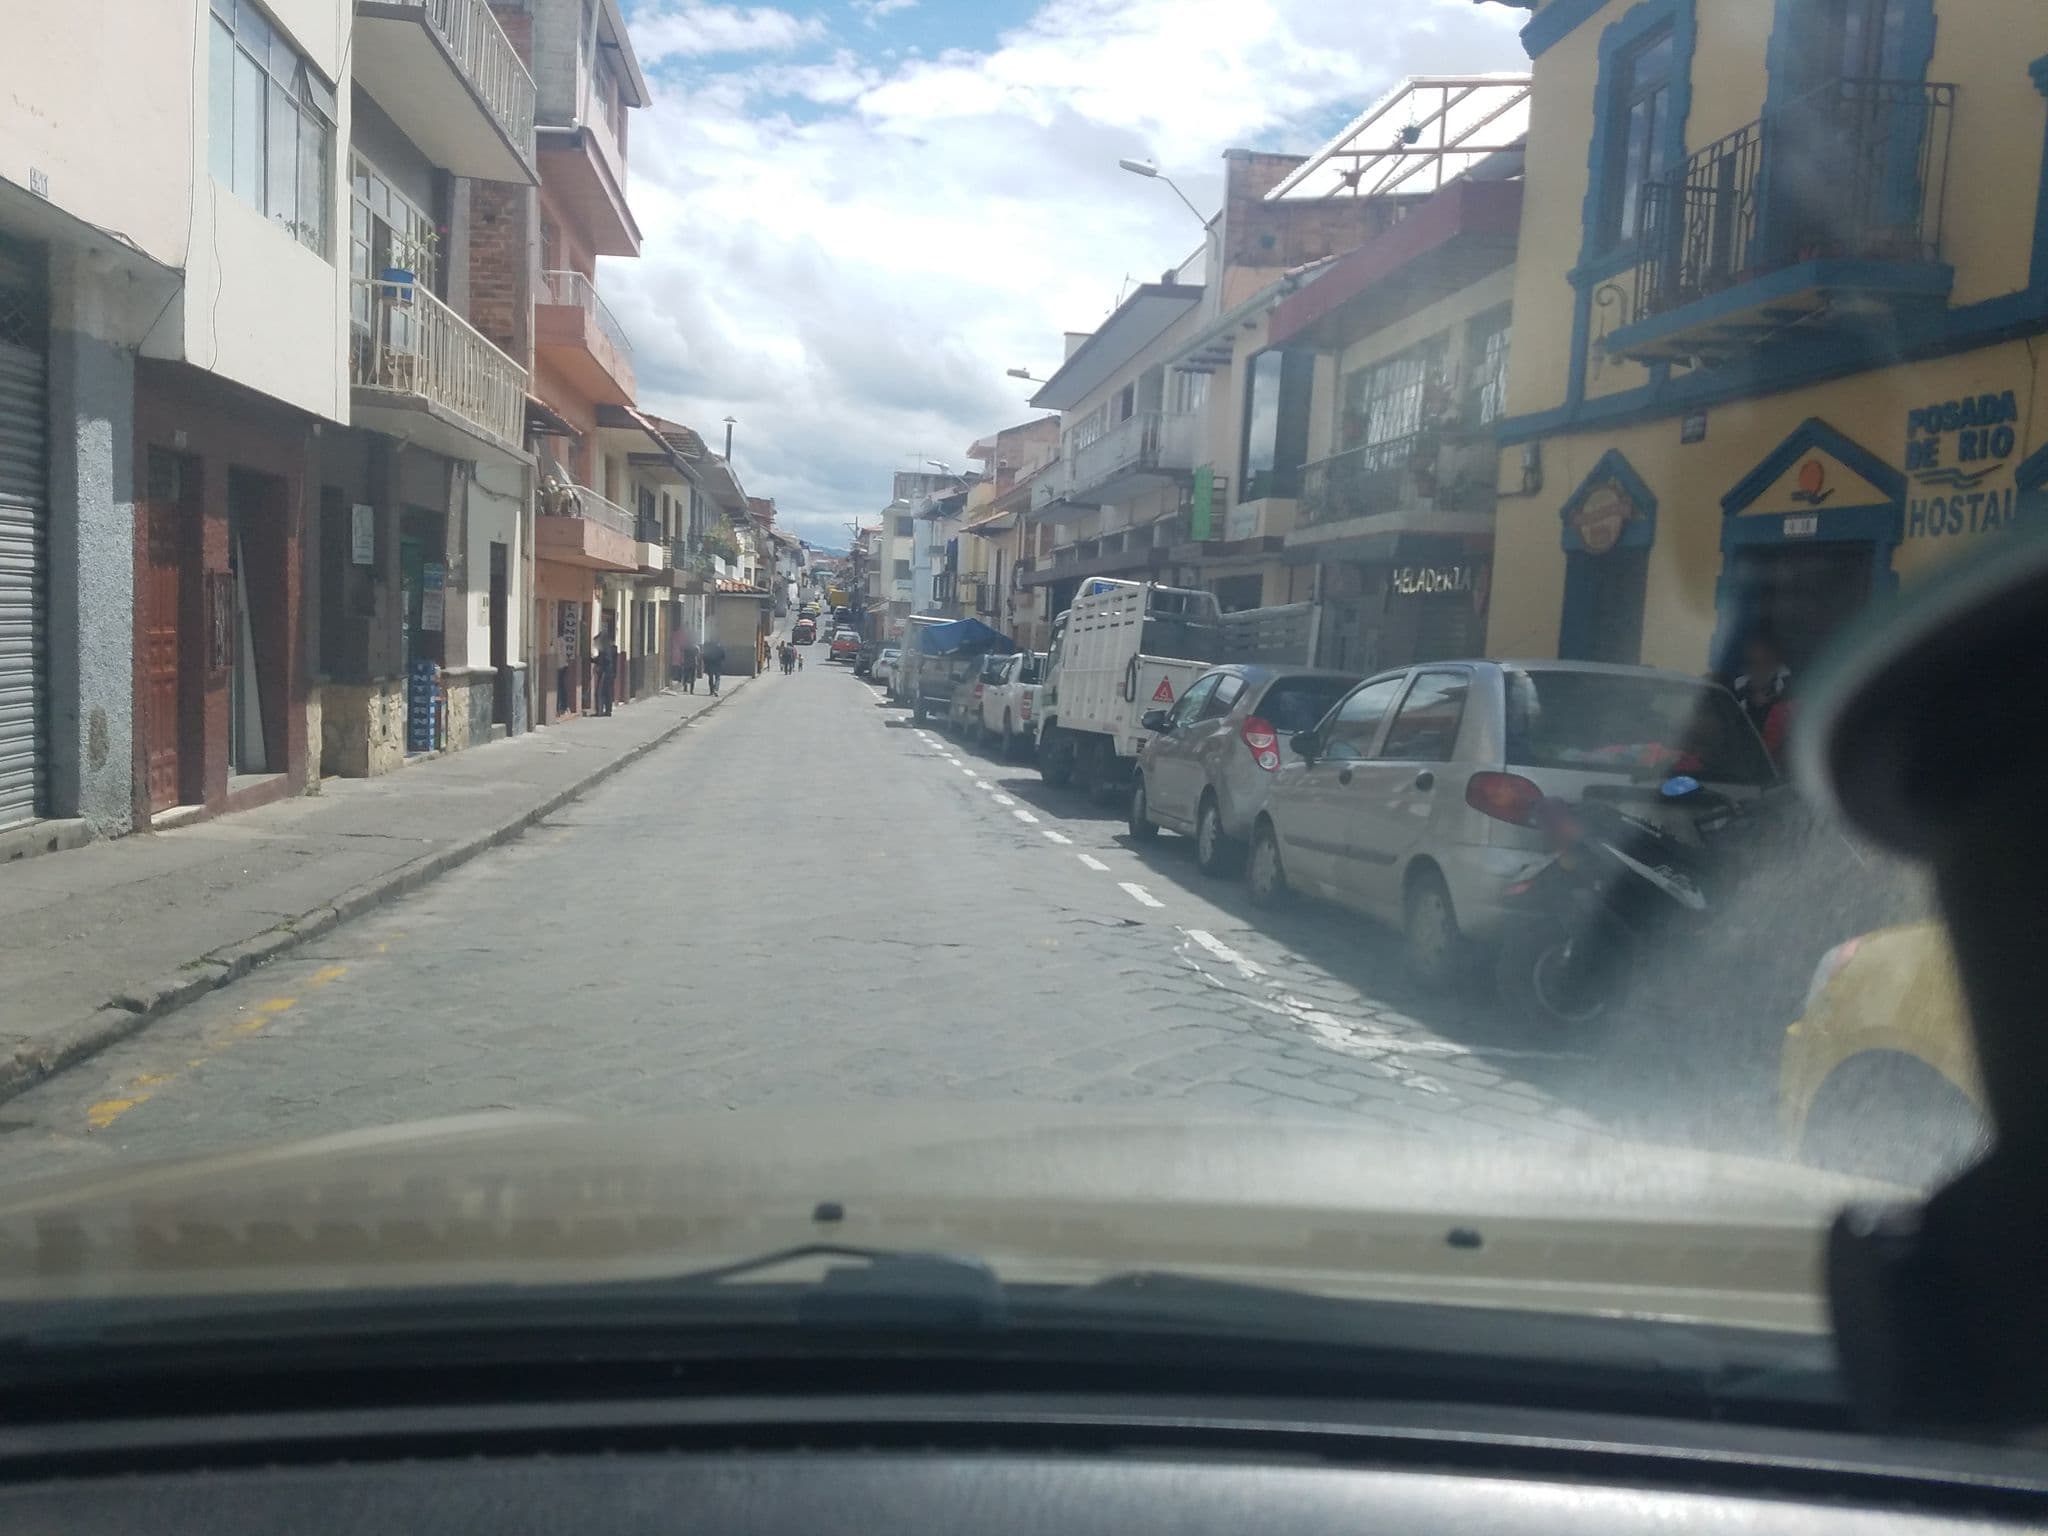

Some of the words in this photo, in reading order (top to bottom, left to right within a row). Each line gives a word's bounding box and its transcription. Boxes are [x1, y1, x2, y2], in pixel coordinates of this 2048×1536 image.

[1907, 390, 2017, 438] POSADA
[1905, 438, 1940, 470] DE
[1959, 425, 2015, 462] RIO
[565, 604, 576, 660] LAUNDRY
